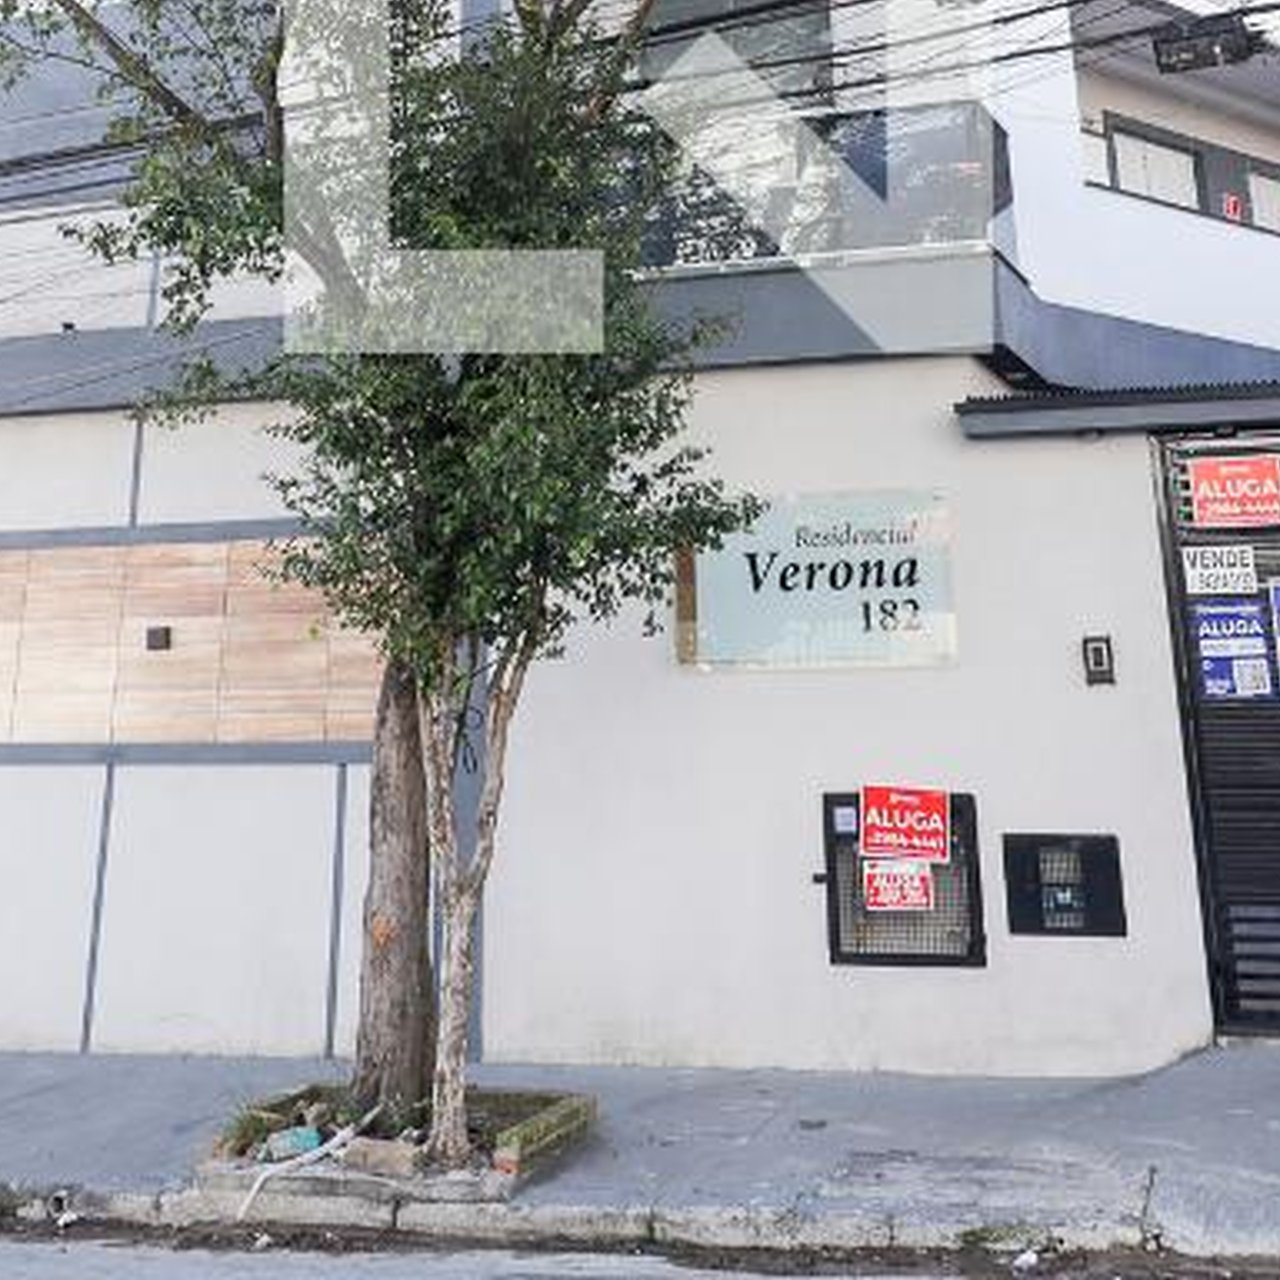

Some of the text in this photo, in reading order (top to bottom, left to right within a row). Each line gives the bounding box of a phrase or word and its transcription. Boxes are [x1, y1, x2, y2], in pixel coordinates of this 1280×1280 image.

[1197, 478, 1280, 499] ALUGA
[794, 519, 919, 549] Residencial
[743, 551, 920, 593] Verona
[1185, 549, 1251, 569] VENDE
[859, 597, 923, 632] 182
[1198, 619, 1265, 637] ALUGA
[865, 806, 945, 832] ALUGA
